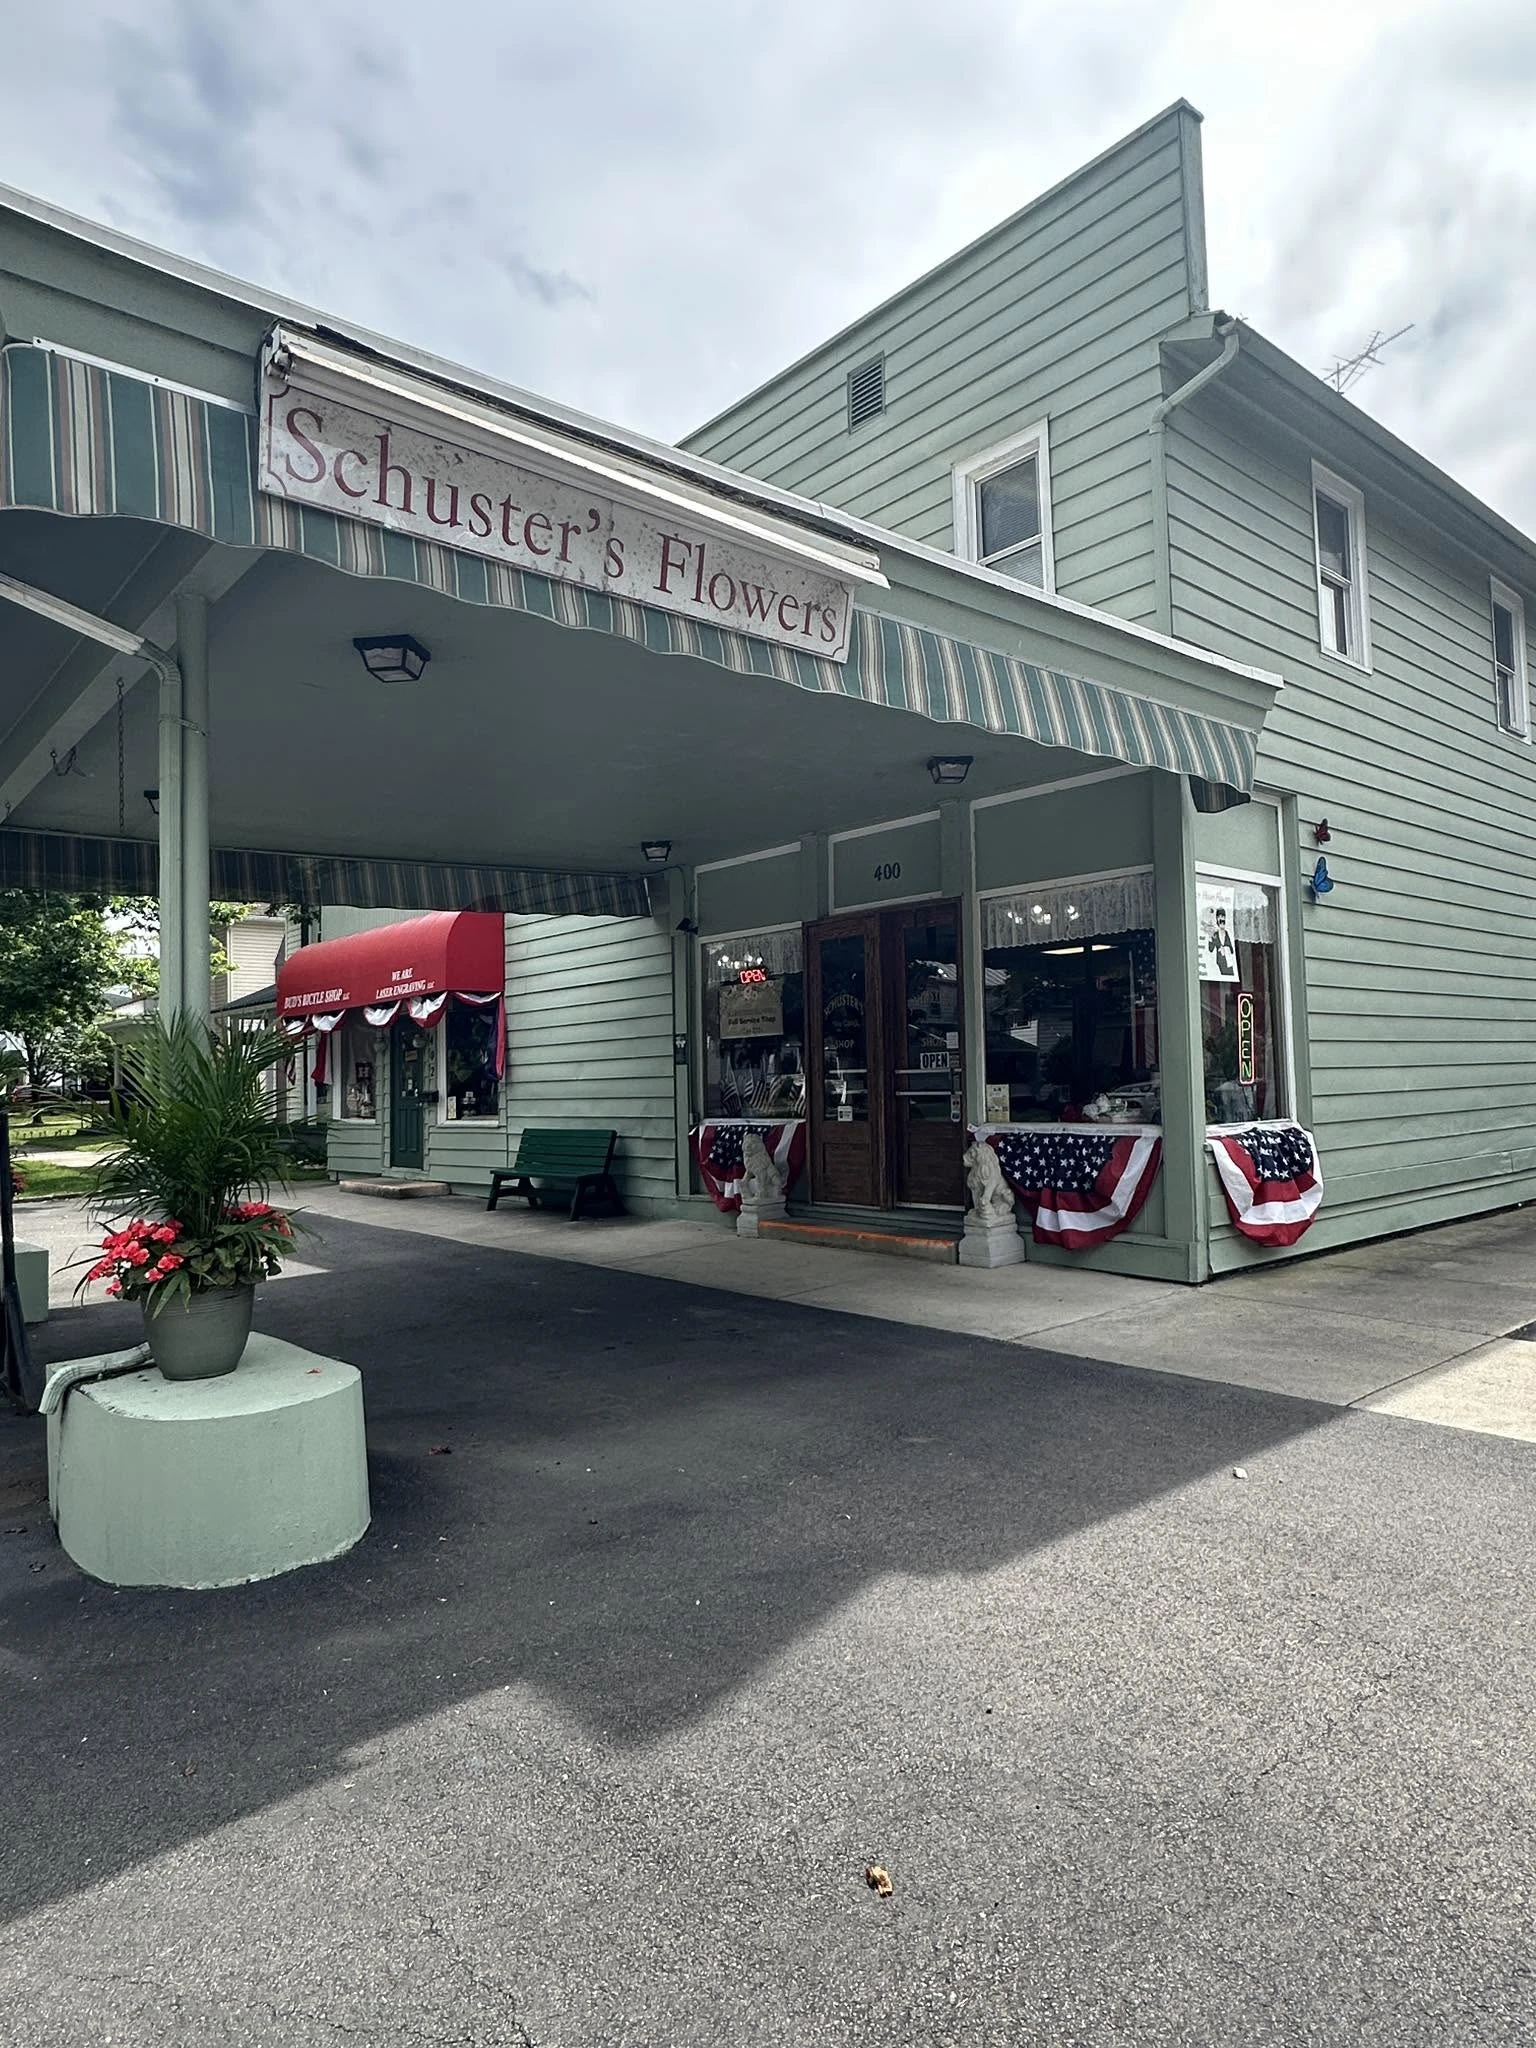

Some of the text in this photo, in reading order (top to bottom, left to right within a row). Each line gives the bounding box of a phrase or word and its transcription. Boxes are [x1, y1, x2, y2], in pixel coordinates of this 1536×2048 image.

[285, 407, 837, 643] Schuster's Flowers
[873, 862, 901, 881] 400
[391, 967, 413, 982] WE ARE
[739, 968, 766, 984] OPEN
[324, 988, 343, 1003] SHOP
[375, 986, 393, 1000] LASER
[393, 979, 426, 996] ENGRAVING
[1240, 998, 1251, 1078] OPEN
[922, 1053, 948, 1068] OPEN
